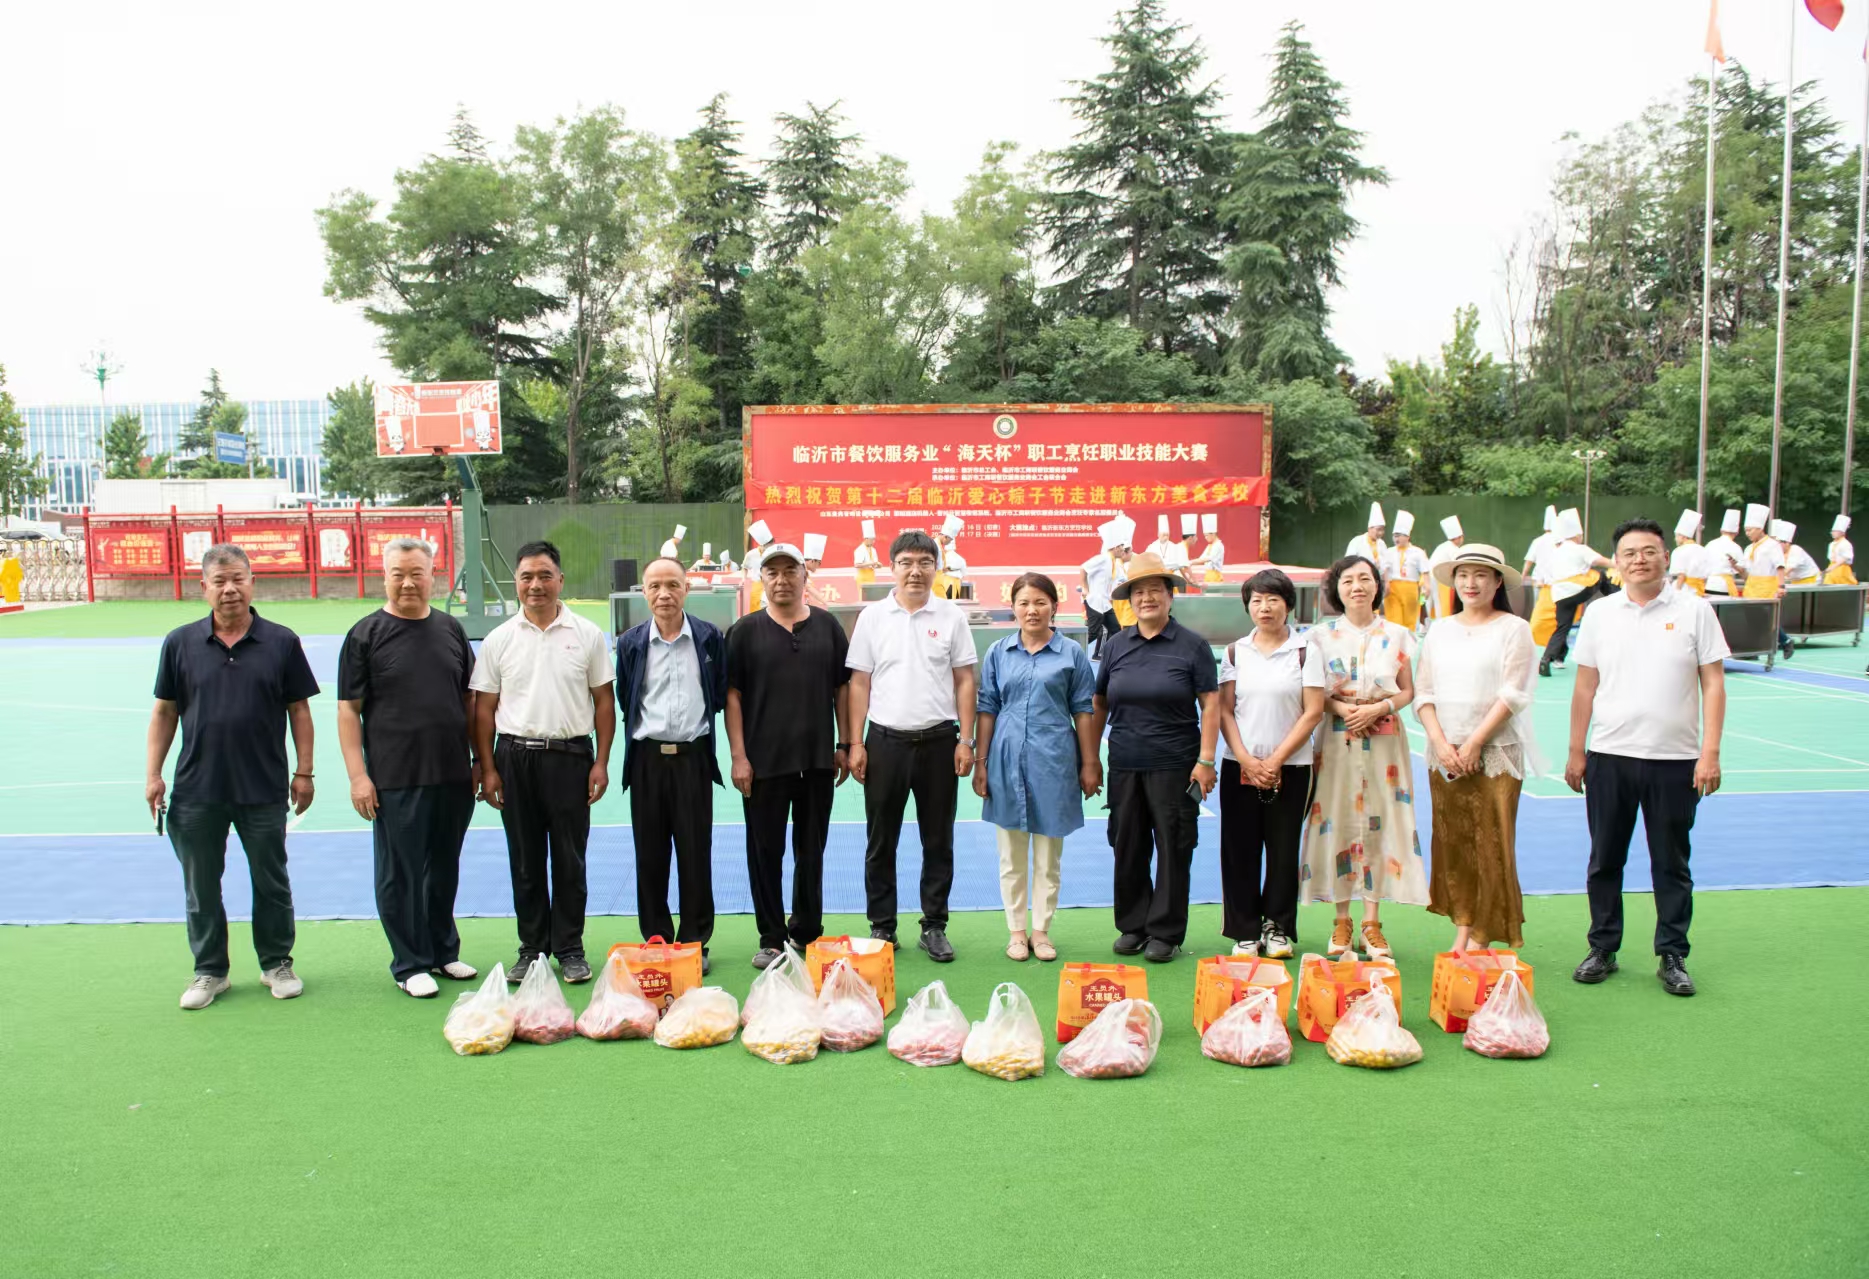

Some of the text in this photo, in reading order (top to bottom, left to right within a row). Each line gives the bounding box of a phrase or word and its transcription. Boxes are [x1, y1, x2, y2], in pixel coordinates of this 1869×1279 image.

[765, 483, 1249, 505] 热烈祝贺第十二届临沂爱心粽子节走进新东方美食学校
[1085, 992, 1122, 1002] 水果罐头
